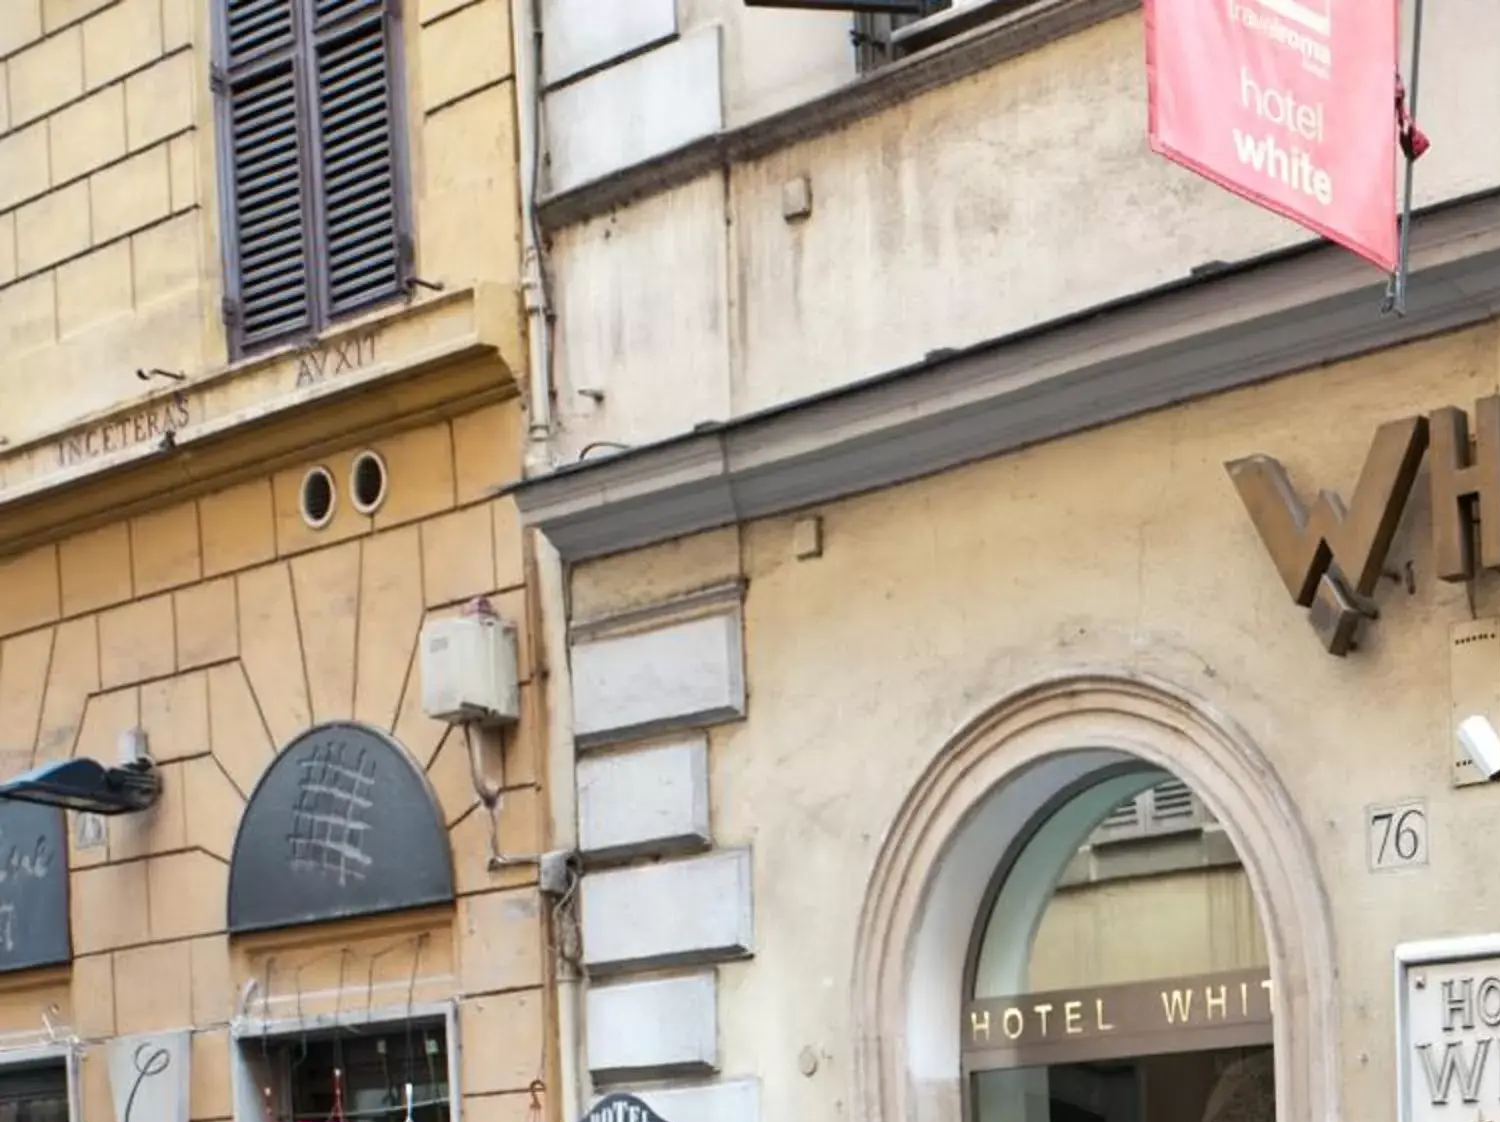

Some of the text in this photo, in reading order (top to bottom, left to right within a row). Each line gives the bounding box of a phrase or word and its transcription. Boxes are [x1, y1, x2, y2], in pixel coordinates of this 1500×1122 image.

[1241, 64, 1324, 143] hotel
[1233, 128, 1333, 206] white
[1371, 808, 1424, 865] 76
[970, 979, 1275, 1041] HOTEL WHIT
